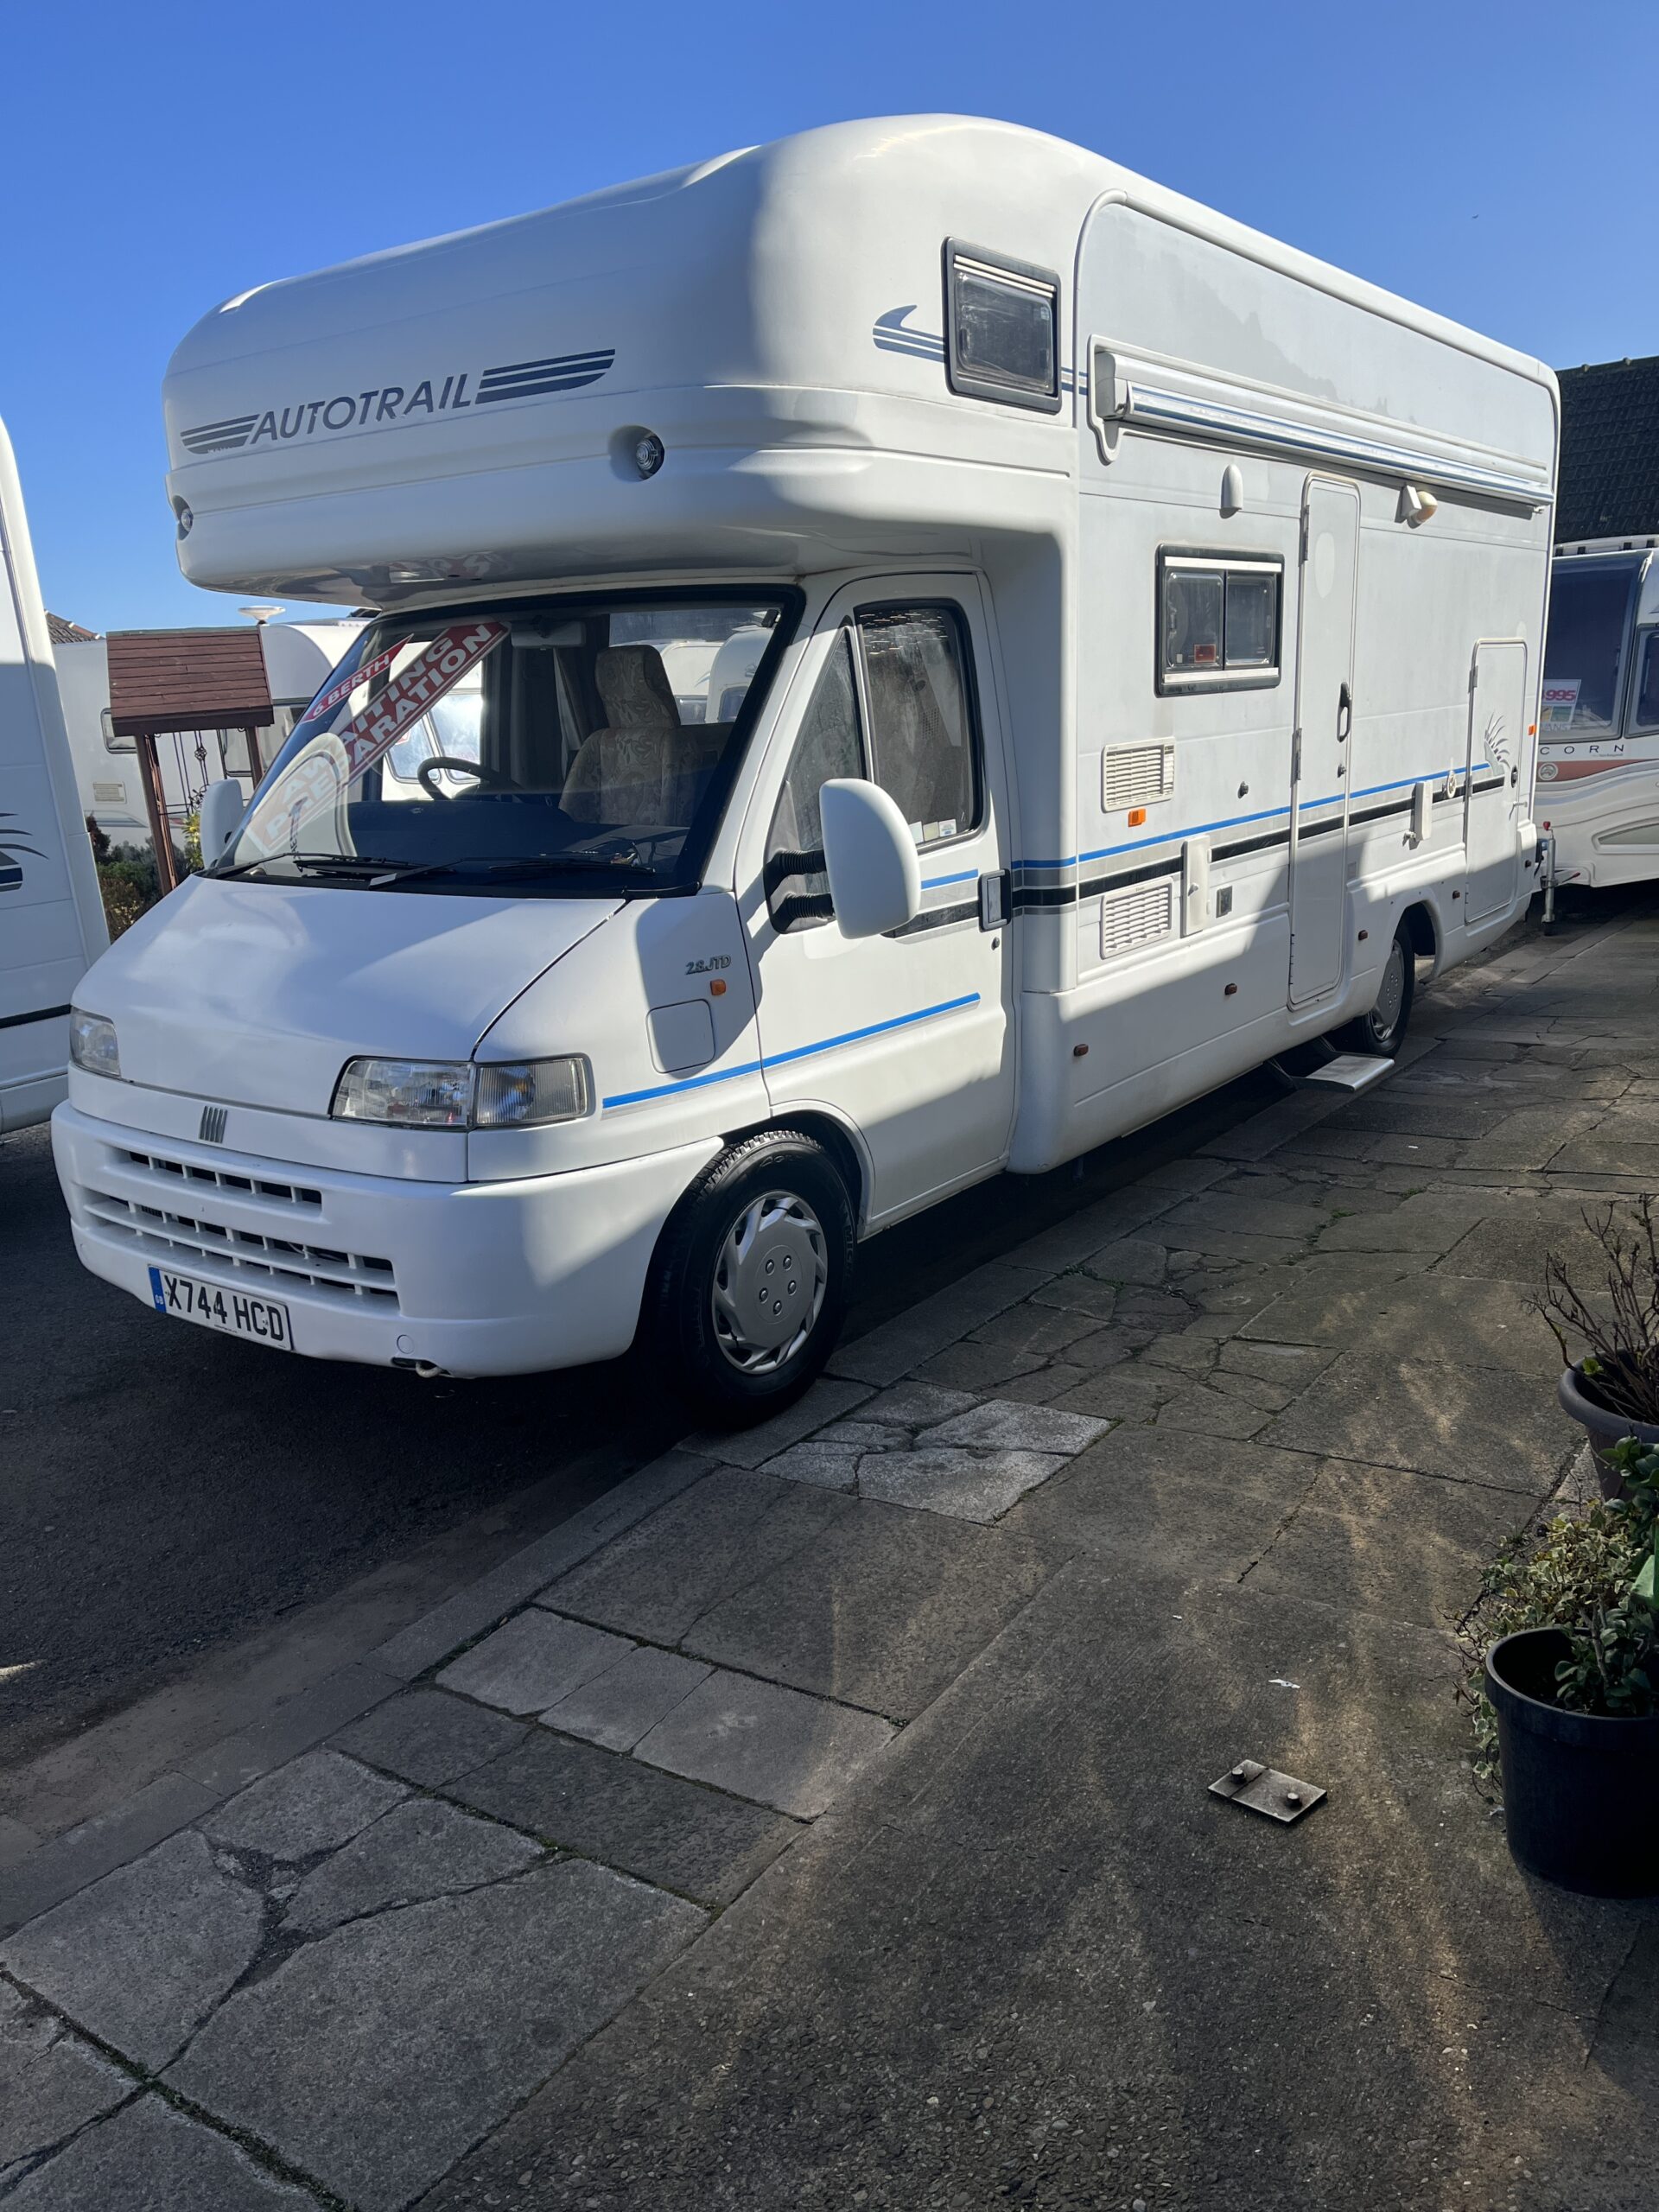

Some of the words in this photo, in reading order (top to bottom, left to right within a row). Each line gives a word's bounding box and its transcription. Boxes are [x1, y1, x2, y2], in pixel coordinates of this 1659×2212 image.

[249, 372, 472, 445] AUTOTRAIL
[313, 702, 325, 717] 6
[327, 654, 391, 704] BERTH
[164, 1274, 227, 1324] X744
[233, 1295, 284, 1342] HCD
